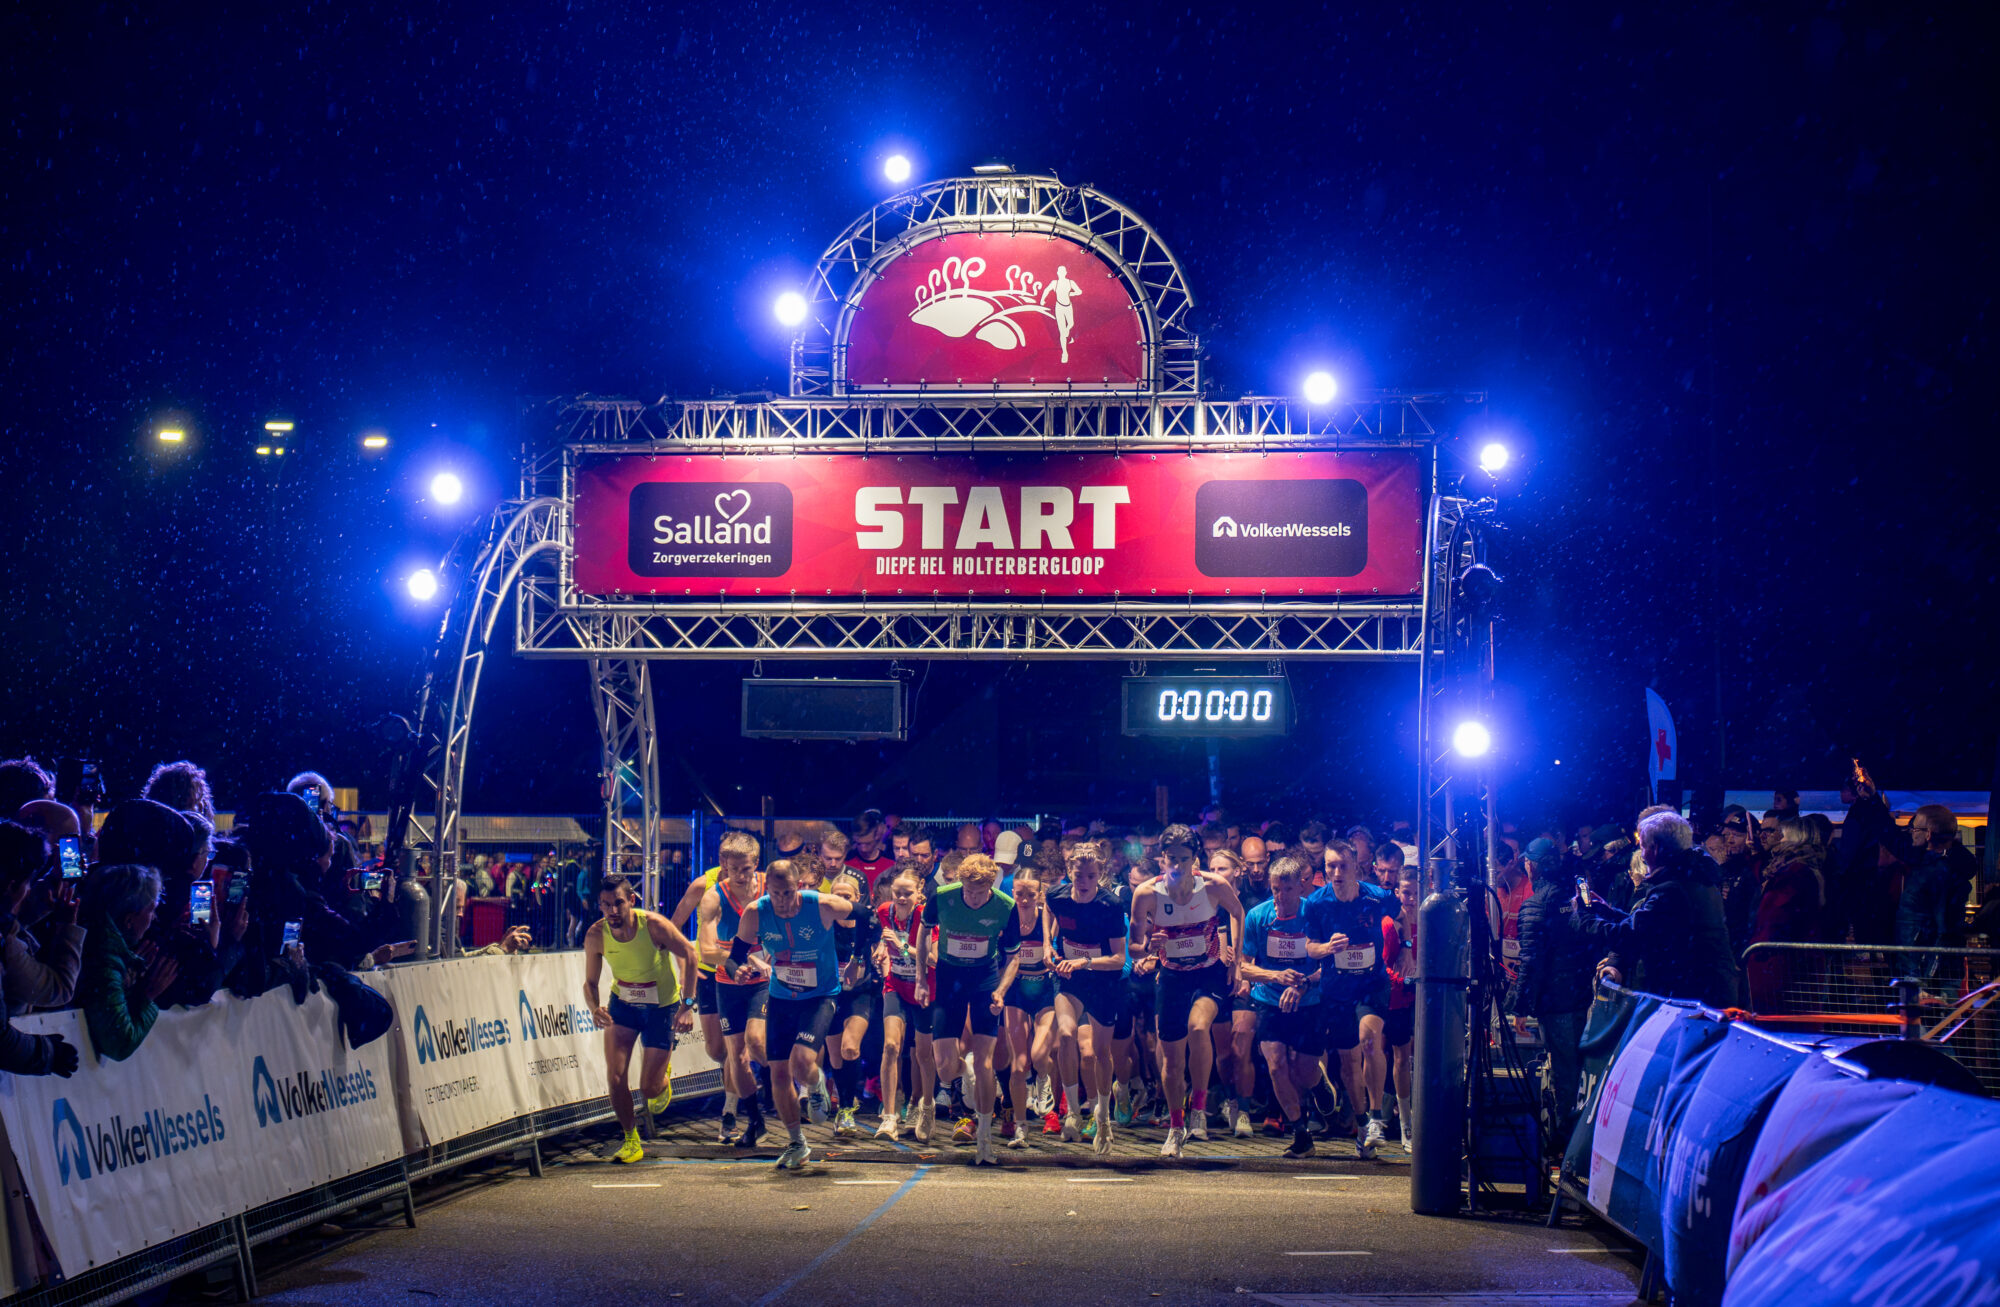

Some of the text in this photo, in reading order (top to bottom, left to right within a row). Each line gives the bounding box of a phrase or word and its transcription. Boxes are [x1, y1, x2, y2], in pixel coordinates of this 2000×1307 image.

[652, 515, 772, 545] Salland
[855, 485, 1131, 550] START
[1239, 522, 1352, 539] VolkerWessels
[652, 552, 772, 566] Zorgverzekeringen
[876, 556, 1105, 576] DIEPE HEL HOLTERBERGLOOP
[1158, 690, 1272, 722] 0:00:00
[276, 1060, 377, 1121] VolkerWessels
[85, 1094, 225, 1175] VolkerWessels
